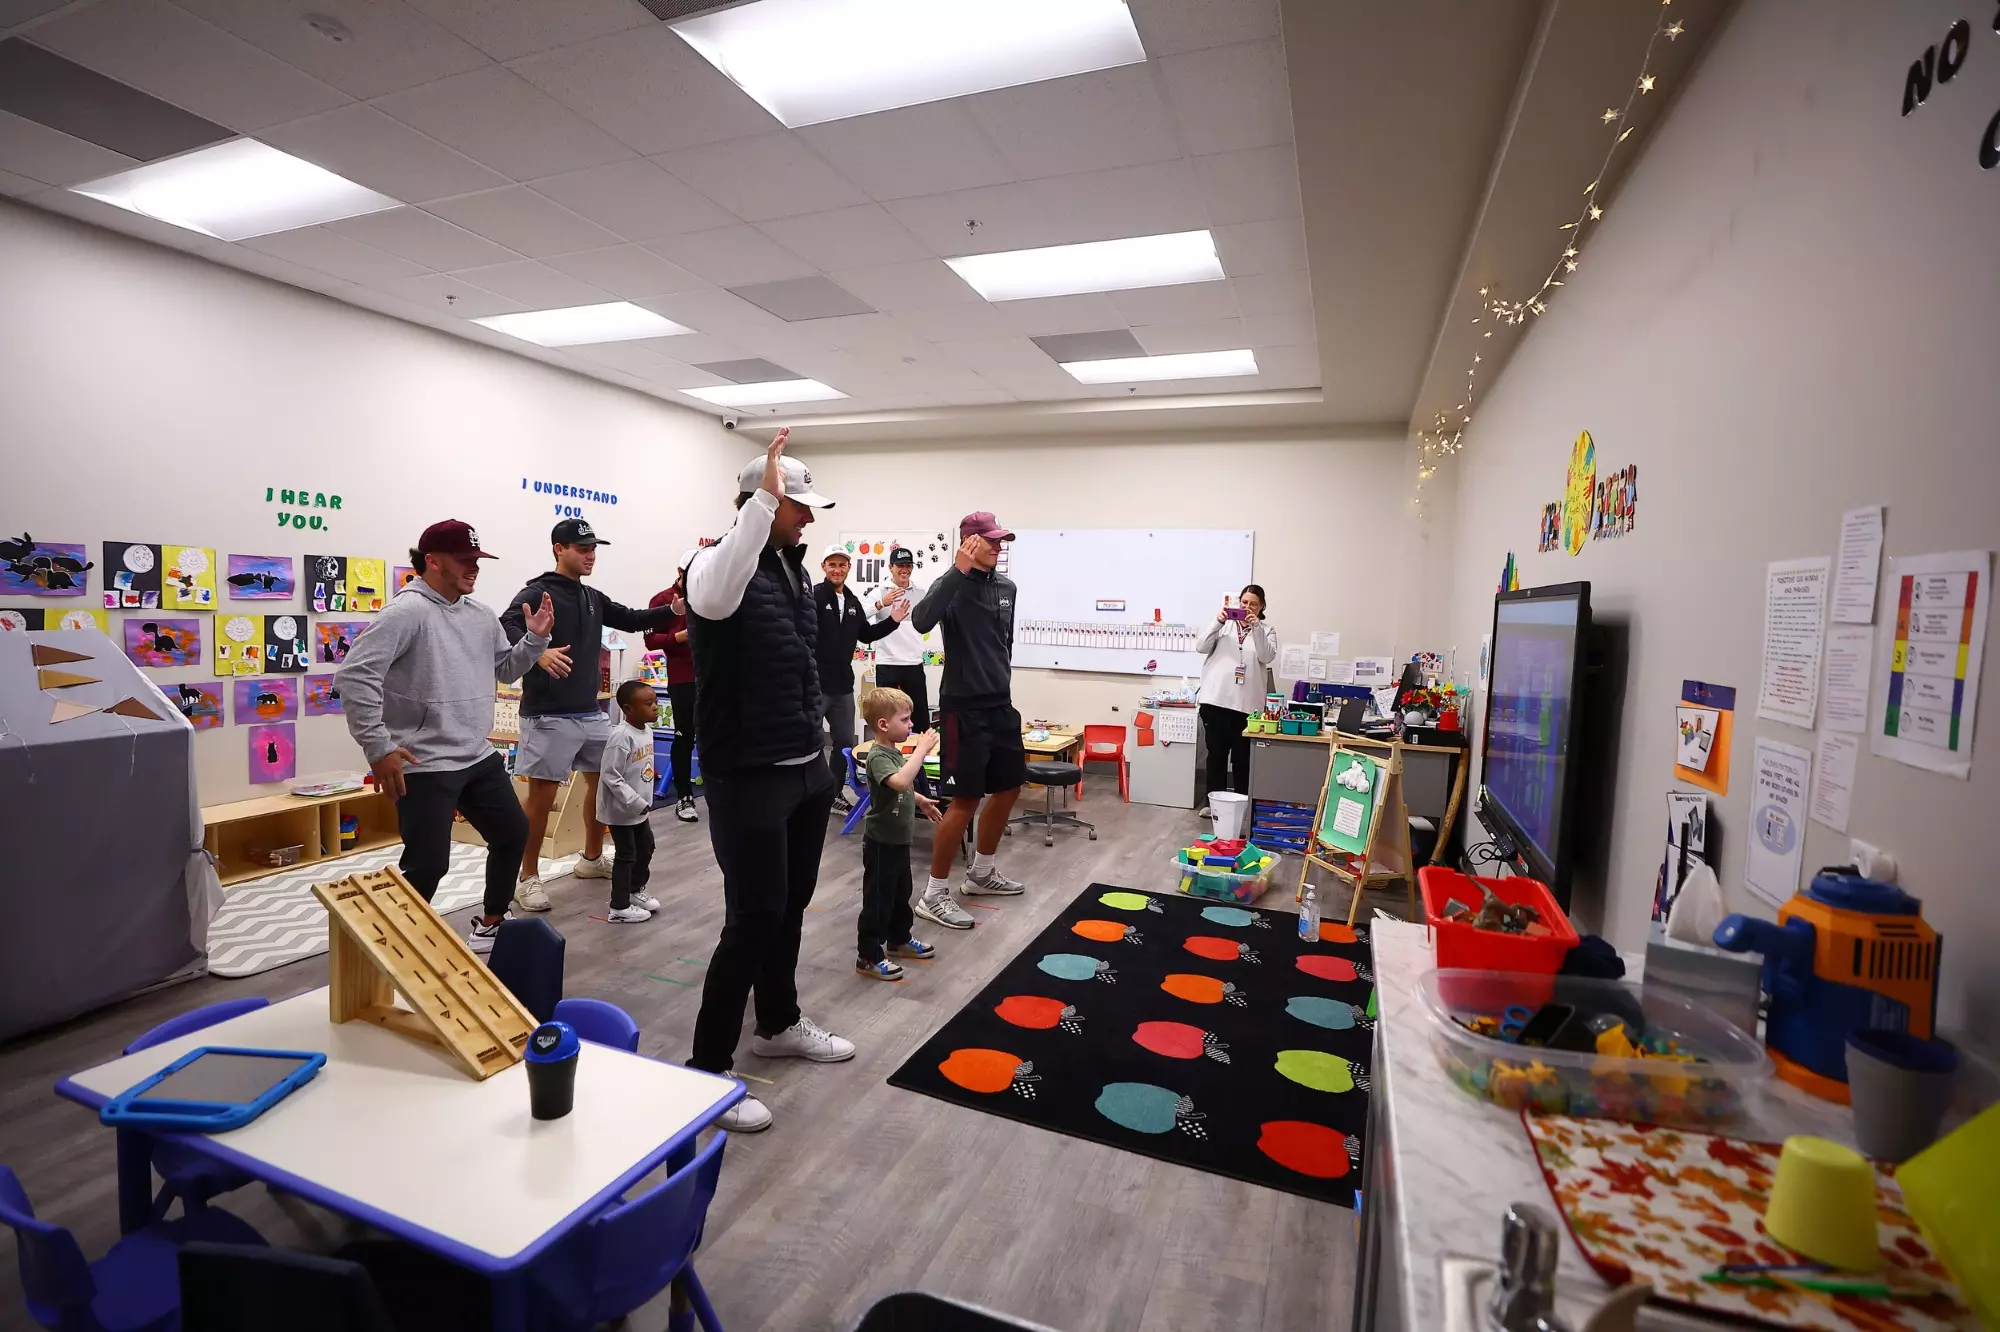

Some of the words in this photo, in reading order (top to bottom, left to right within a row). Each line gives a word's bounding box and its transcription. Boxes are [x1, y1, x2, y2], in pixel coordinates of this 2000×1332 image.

[1902, 19, 1970, 117] NO
[266, 487, 273, 502] I
[281, 489, 342, 510] HEAR
[522, 478, 527, 490] I
[534, 481, 618, 505] UNDERSTAND
[277, 512, 328, 532] YOU.
[554, 504, 584, 519] YOU.
